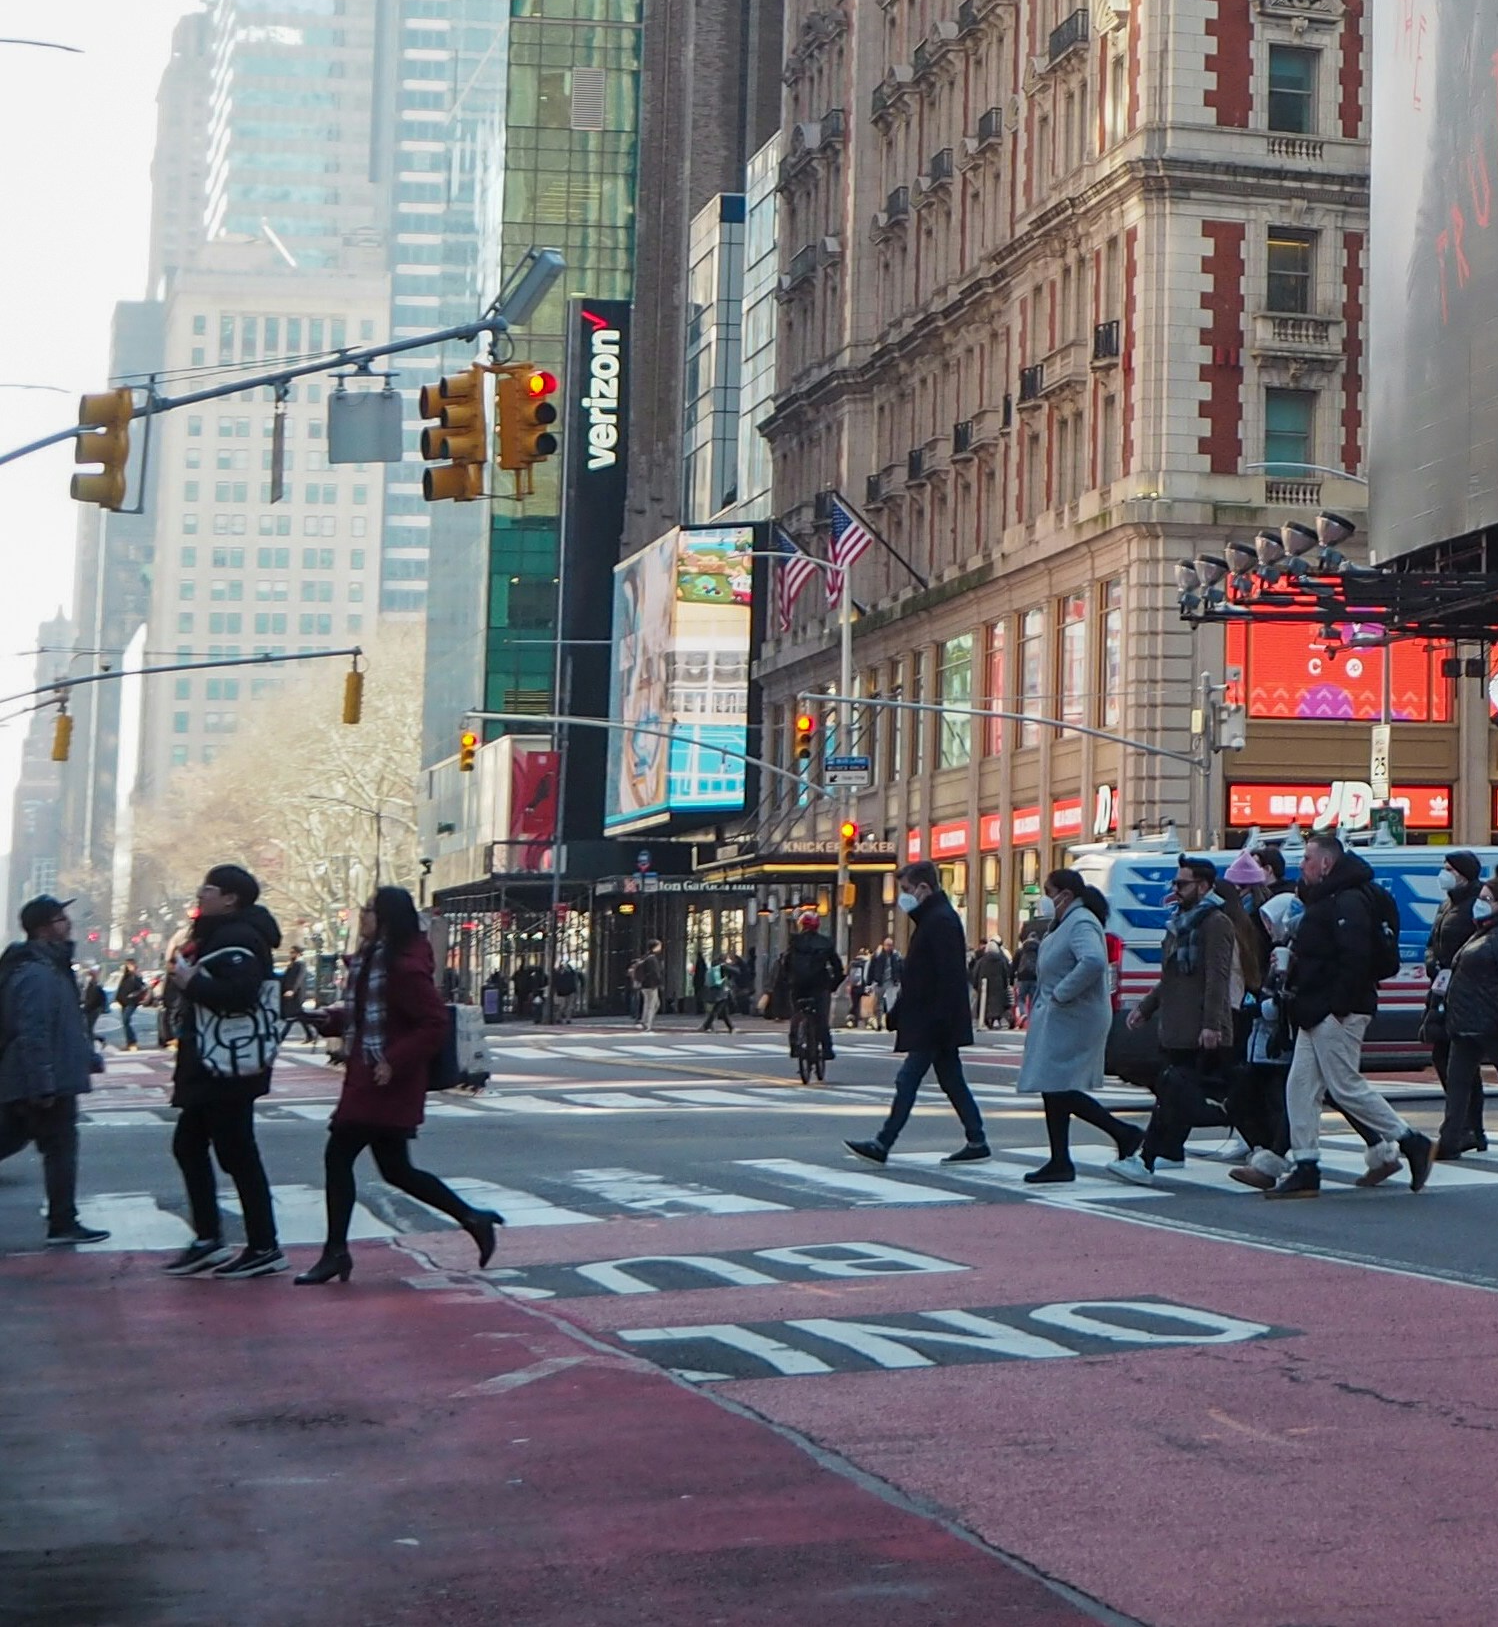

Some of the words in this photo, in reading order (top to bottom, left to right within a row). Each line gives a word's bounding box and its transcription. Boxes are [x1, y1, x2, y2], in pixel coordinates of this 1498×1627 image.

[586, 328, 620, 471] verizon
[1374, 756, 1386, 777] 25
[1312, 780, 1374, 832] JD
[783, 840, 897, 854] KNICKEROCKER
